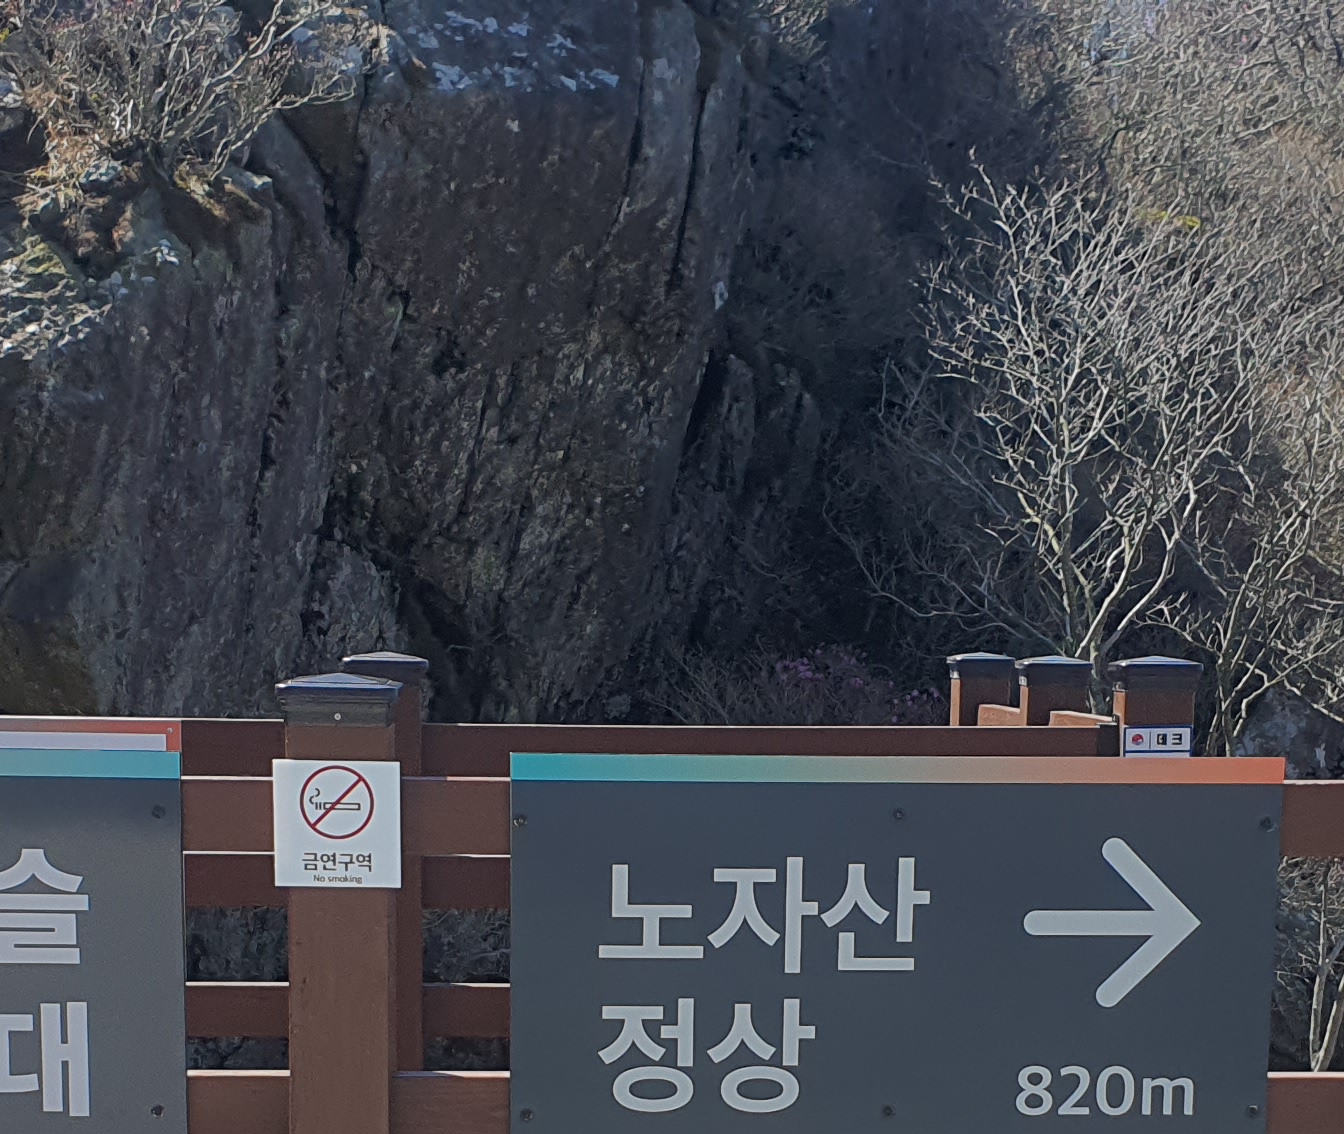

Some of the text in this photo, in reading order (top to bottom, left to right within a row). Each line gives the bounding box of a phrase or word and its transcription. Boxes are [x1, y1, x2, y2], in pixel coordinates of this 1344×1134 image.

[301, 852, 372, 873] 금연구역
[313, 874, 363, 884] No smoking
[598, 856, 931, 974] 노자산
[597, 997, 816, 1113] 정상
[1015, 1065, 1194, 1116] 820m
